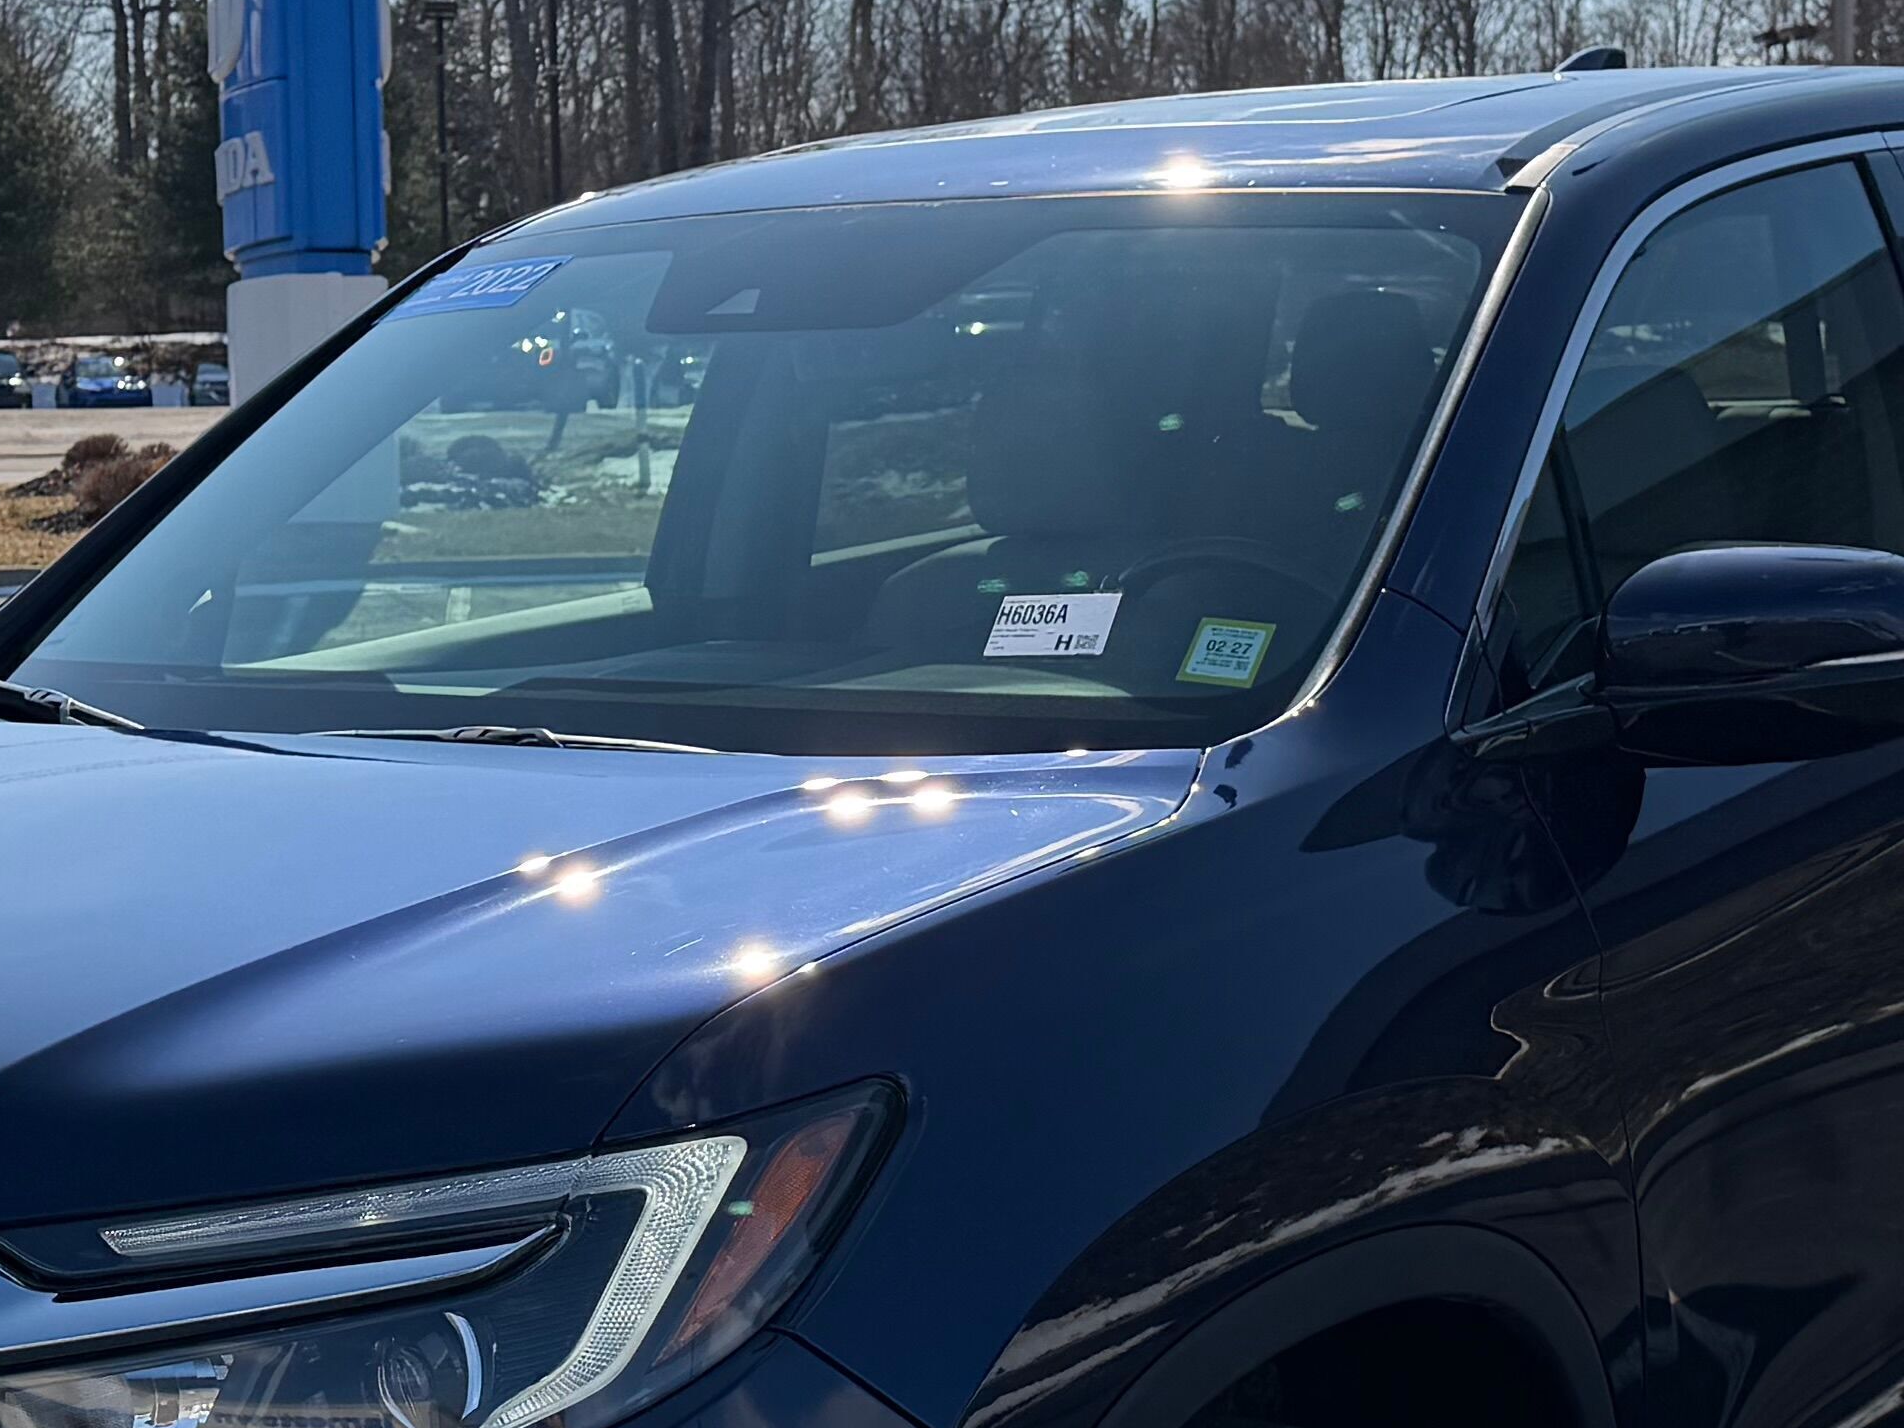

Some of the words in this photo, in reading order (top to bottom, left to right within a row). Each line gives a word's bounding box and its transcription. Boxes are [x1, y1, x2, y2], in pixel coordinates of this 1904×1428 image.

[447, 262, 556, 300] 2022
[997, 604, 1070, 626] H6036A
[1206, 639, 1228, 653] 02
[1231, 641, 1253, 655] 27
